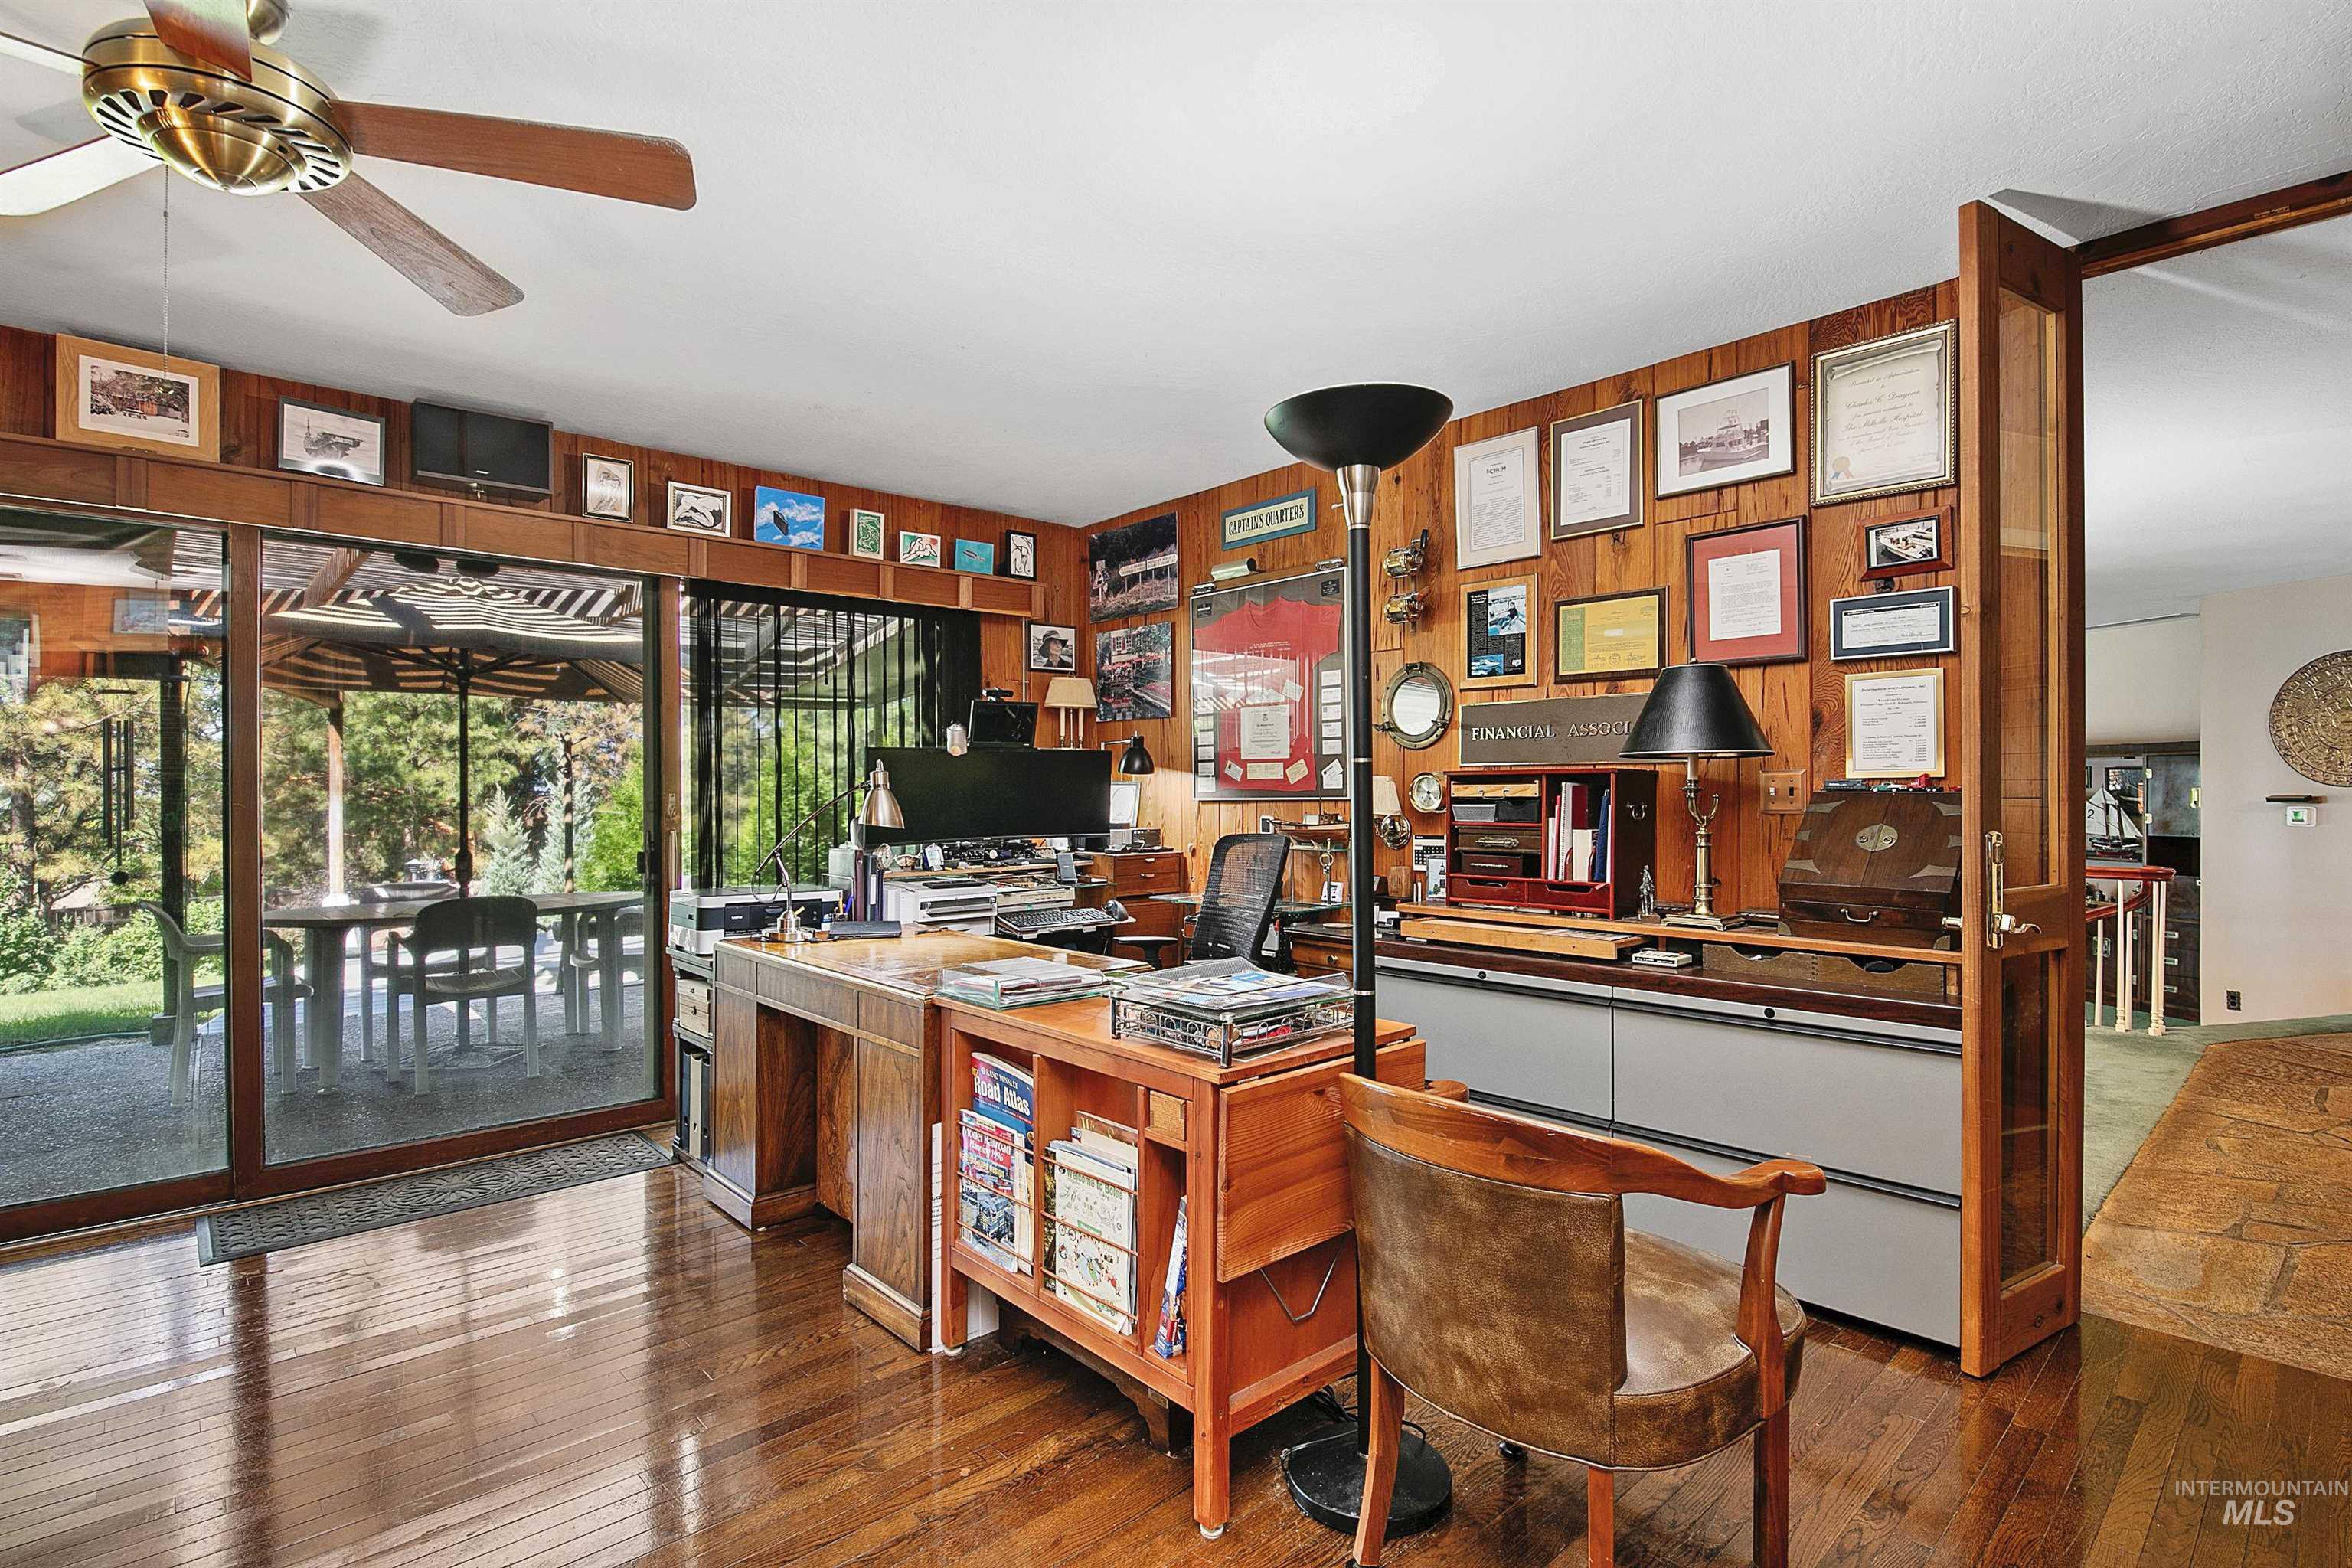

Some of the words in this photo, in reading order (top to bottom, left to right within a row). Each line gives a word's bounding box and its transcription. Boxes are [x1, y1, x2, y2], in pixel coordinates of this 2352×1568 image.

[1228, 512, 1264, 536] CAPTAIN'S
[1266, 504, 1305, 528] QUARTERS
[1471, 723, 1557, 741] FINANCIAL
[1567, 720, 1631, 737] ASSOCI
[2087, 808, 2095, 819] 2
[974, 1076, 1001, 1103] Road
[1004, 1086, 1031, 1116] Atlas
[962, 1125, 983, 1143] Model
[984, 1135, 1011, 1156] Railroad
[1072, 1129, 1082, 1139] DVD
[991, 1149, 1004, 1162] 1996
[1067, 1168, 1095, 1188] Welcome
[1096, 1181, 1103, 1191] to
[1104, 1184, 1123, 1200] Boise
